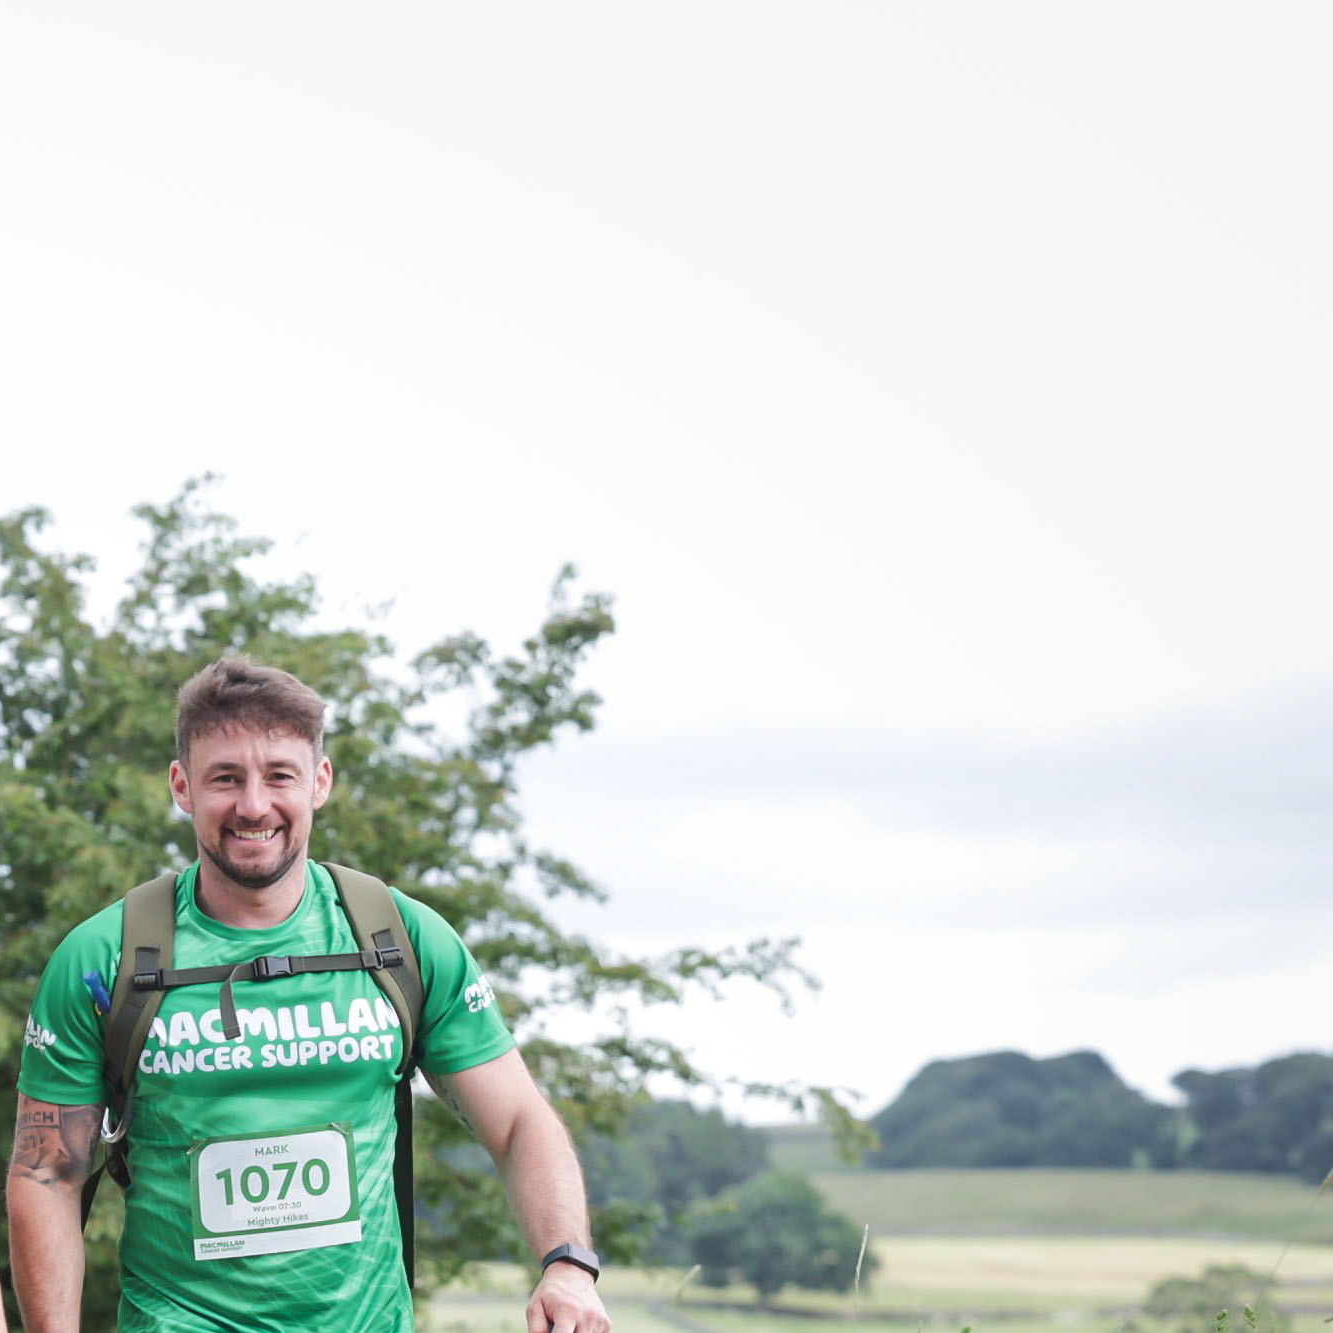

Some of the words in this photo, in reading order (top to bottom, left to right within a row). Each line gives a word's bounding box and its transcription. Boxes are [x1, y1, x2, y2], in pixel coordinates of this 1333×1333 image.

[138, 1046, 254, 1075] CANCER
[260, 1035, 394, 1068] SUPPORT
[255, 1144, 289, 1157] MARK
[215, 1158, 331, 1206] 1070
[278, 1201, 302, 1210] 07:30
[247, 1215, 281, 1228] Mighty
[283, 1213, 309, 1223] Hikes
[199, 1239, 245, 1249] MACMILLAN
